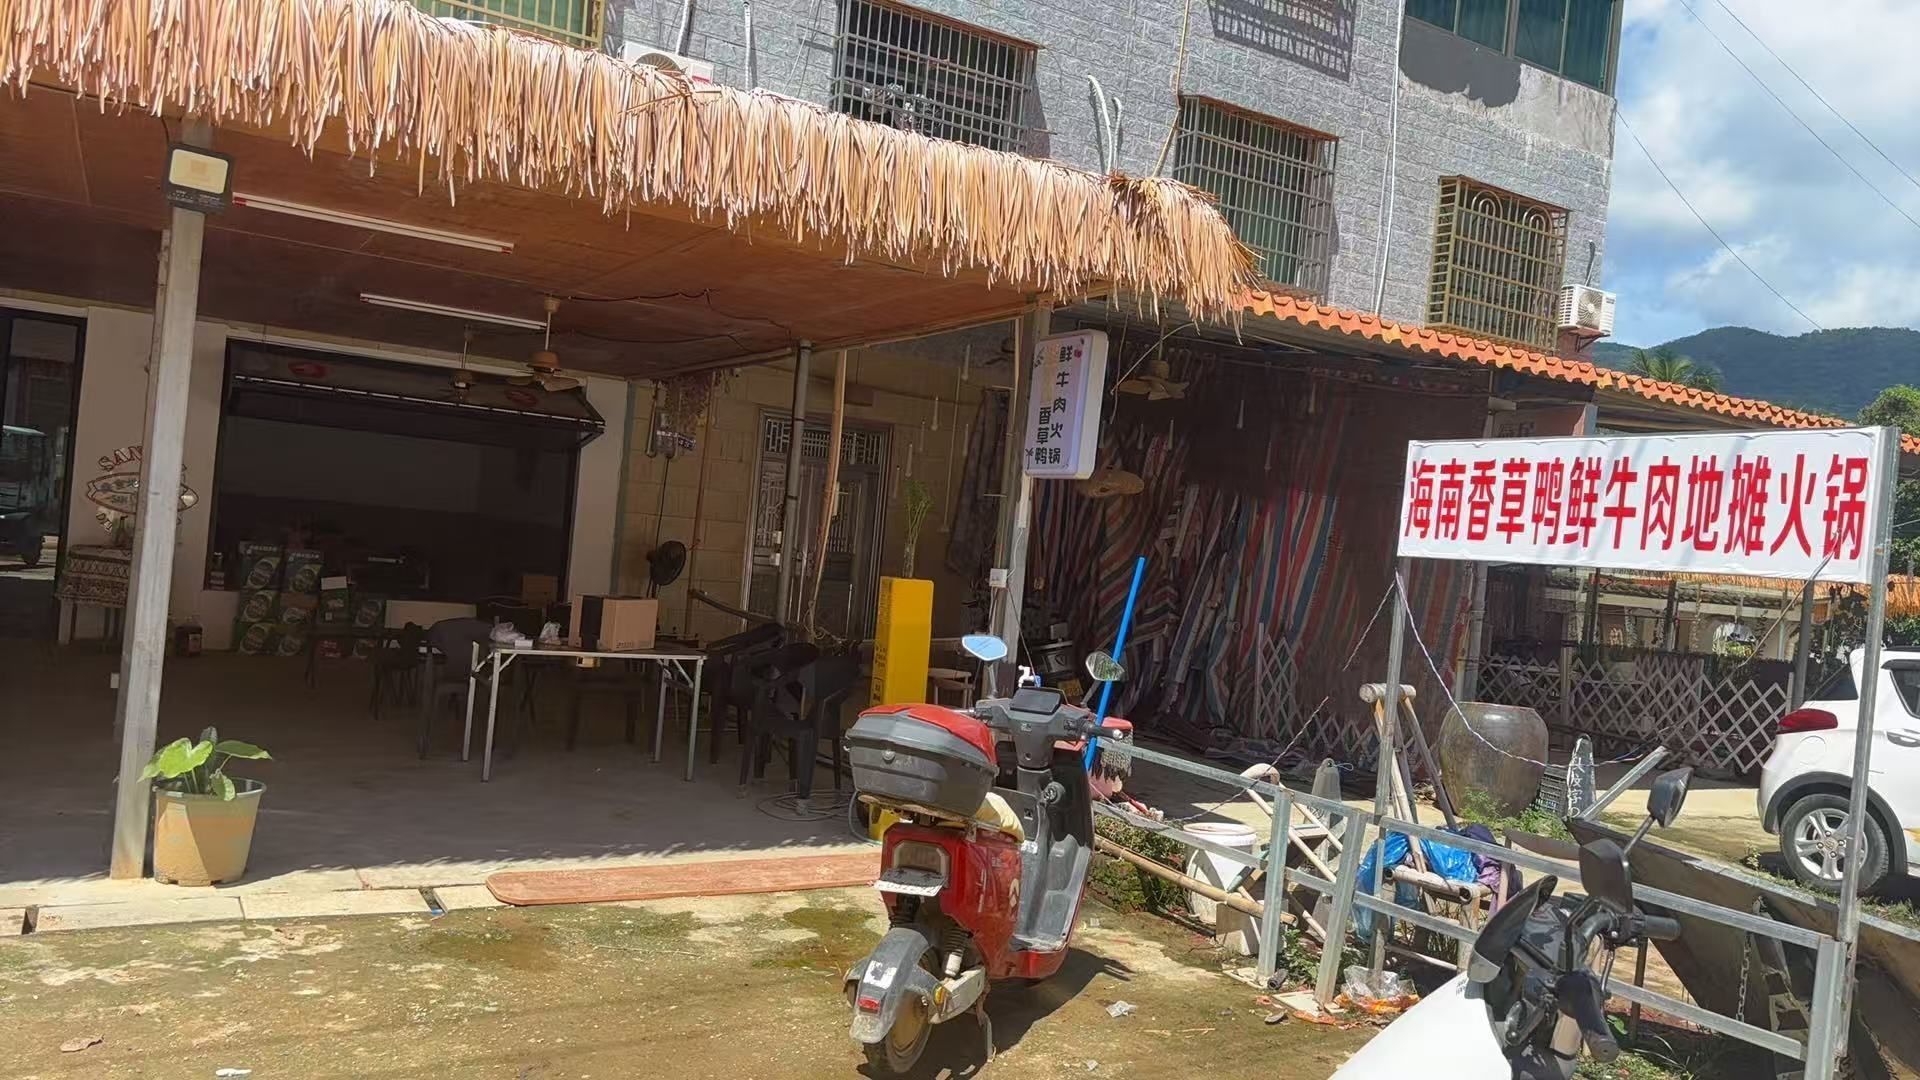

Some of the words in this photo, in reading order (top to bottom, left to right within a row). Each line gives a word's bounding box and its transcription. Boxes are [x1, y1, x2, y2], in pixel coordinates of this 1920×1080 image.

[1034, 406, 1052, 464] 香草鸭
[1049, 346, 1073, 464] 鲜牛肉火锅
[1404, 453, 1870, 560] 海南香草鸭鲜牛肉地摊火锅
